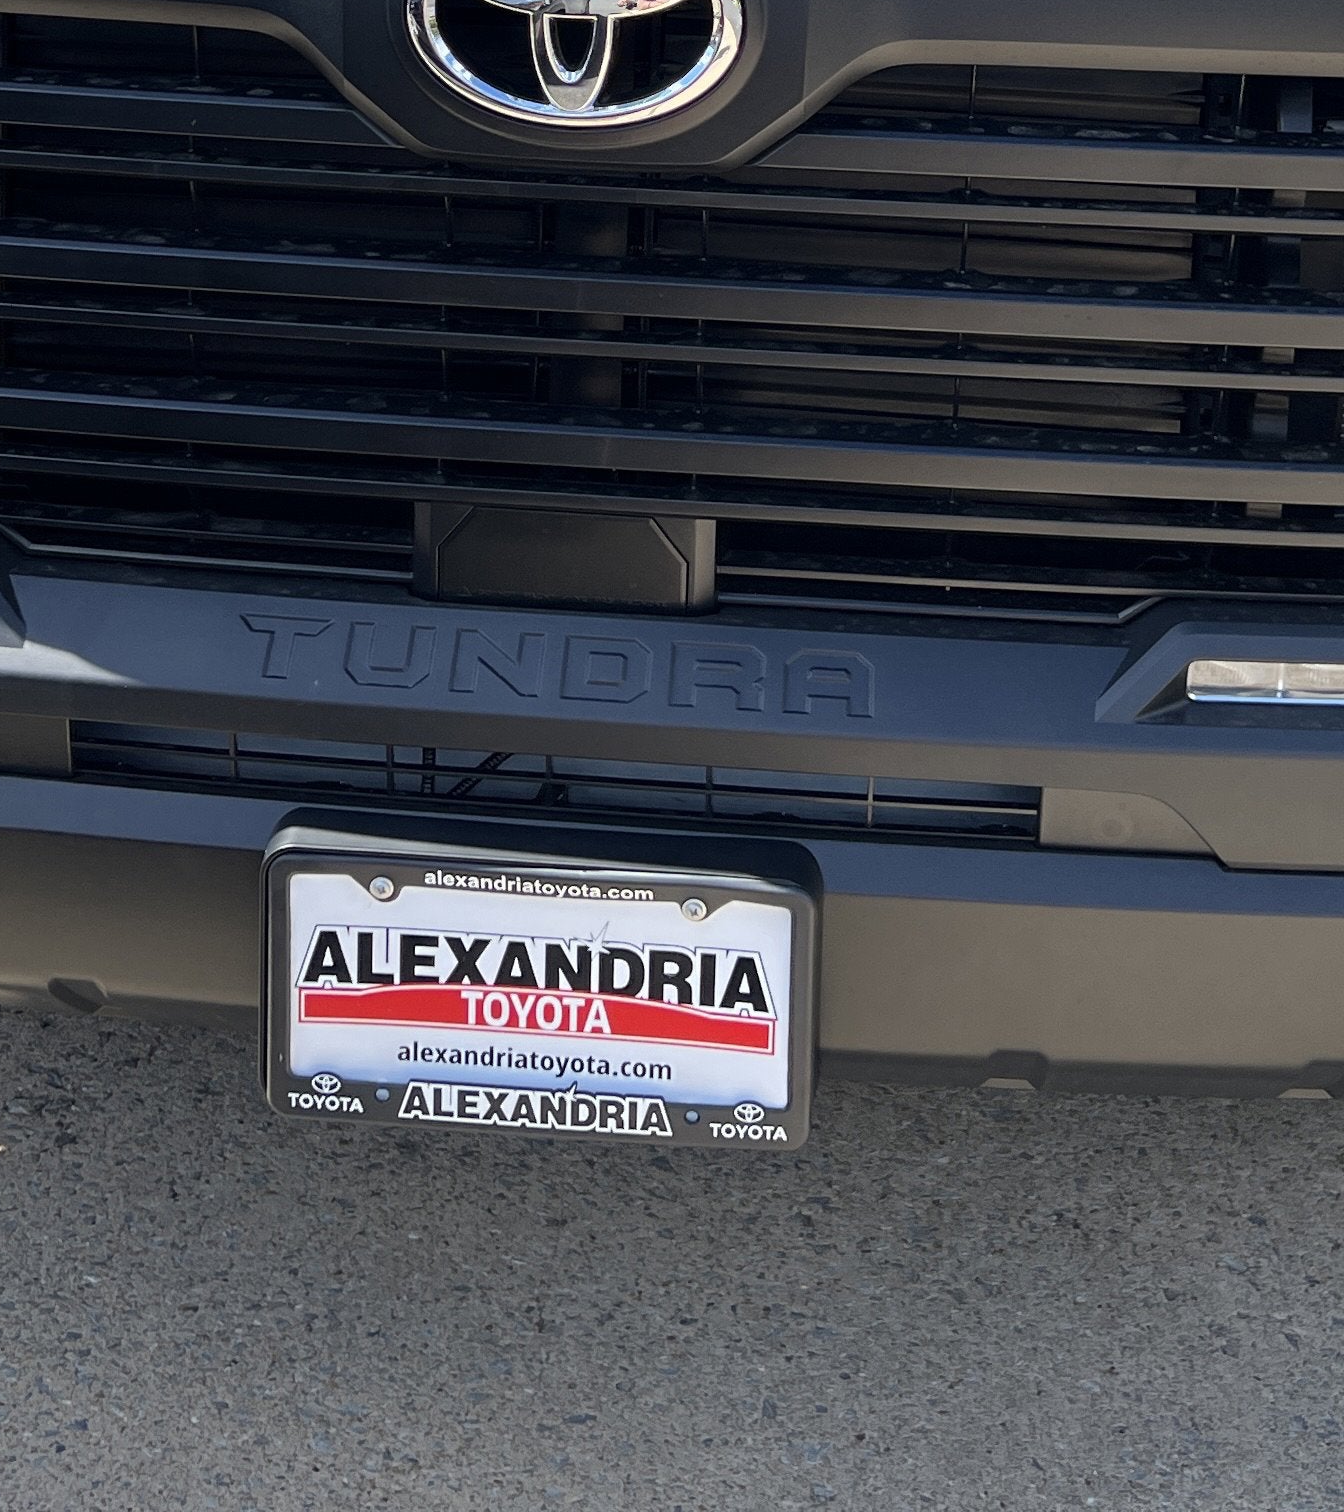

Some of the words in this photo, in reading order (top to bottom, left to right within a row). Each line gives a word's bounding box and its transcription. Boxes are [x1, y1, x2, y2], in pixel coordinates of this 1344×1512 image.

[240, 614, 874, 717] TUNDRA
[424, 870, 654, 900] alexandriatoyota.com
[301, 930, 770, 1014] ALEXANDRIA
[460, 990, 612, 1034] TOYOTA
[397, 1041, 672, 1080] alexandriatoyota.com
[288, 1092, 364, 1113] TOYOTA
[398, 1082, 673, 1137] ALEXANDRIA
[709, 1122, 788, 1141] TOYOTA
